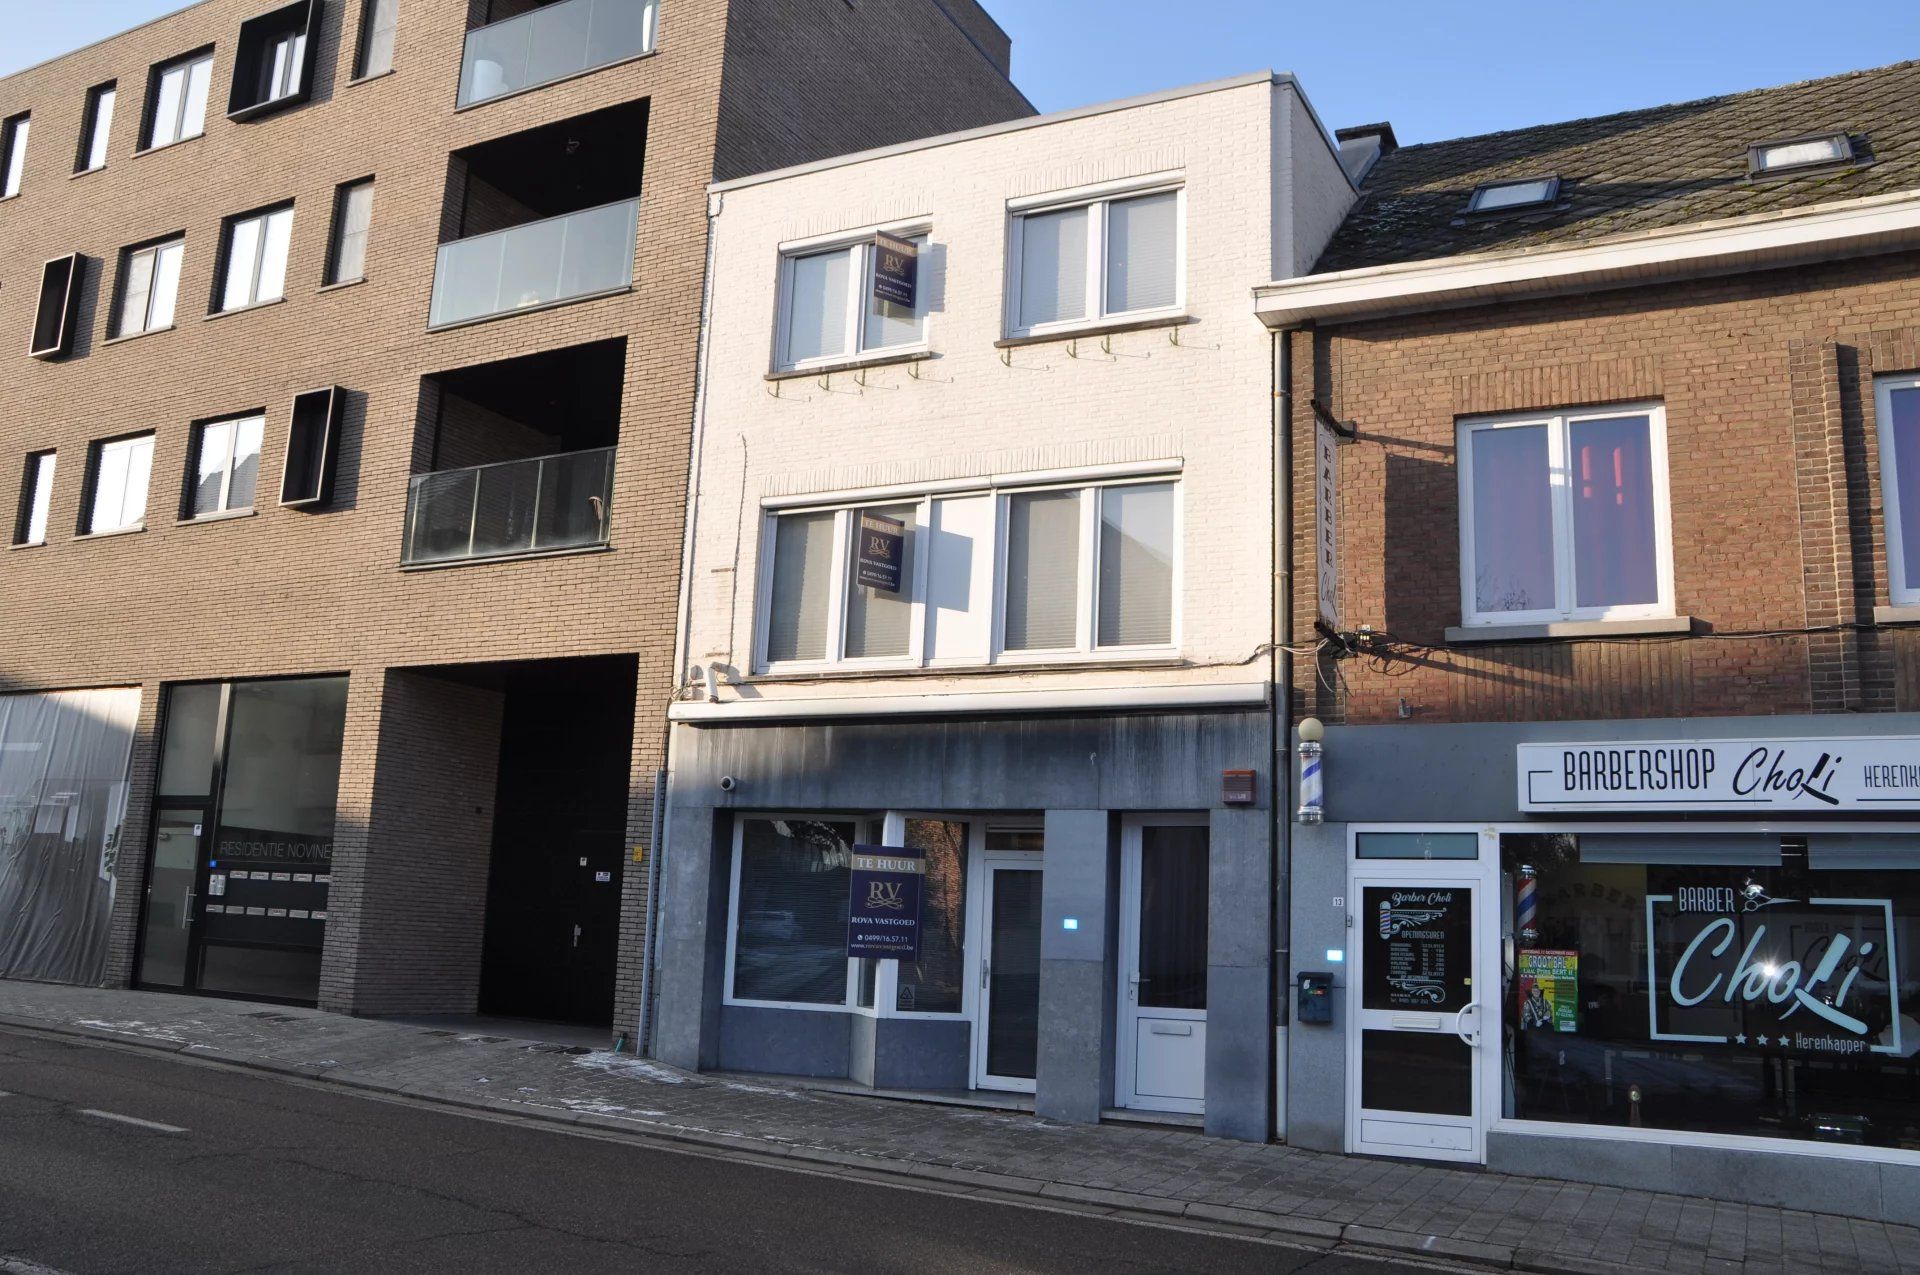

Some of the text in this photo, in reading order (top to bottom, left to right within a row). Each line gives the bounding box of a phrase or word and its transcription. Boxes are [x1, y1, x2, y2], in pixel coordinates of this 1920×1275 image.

[1323, 445, 1334, 569] BARBER
[870, 536, 891, 551] RV
[1563, 748, 1715, 791] BARBERSHOP
[1863, 764, 1920, 788] HERENK
[220, 841, 332, 859] RESIDENTIE NOVINE
[857, 857, 915, 871] TE HUUR
[869, 881, 903, 900] RV
[1392, 891, 1426, 907] Barber
[1678, 886, 1735, 913] BARBER
[851, 916, 916, 927] ROVA VASTGOED
[864, 934, 908, 943] 0499/16.57.11
[1401, 930, 1445, 940] OPENINGSUREN
[1528, 955, 1567, 969] GROOT BAL
[1795, 1032, 1867, 1054] Herenkapper
